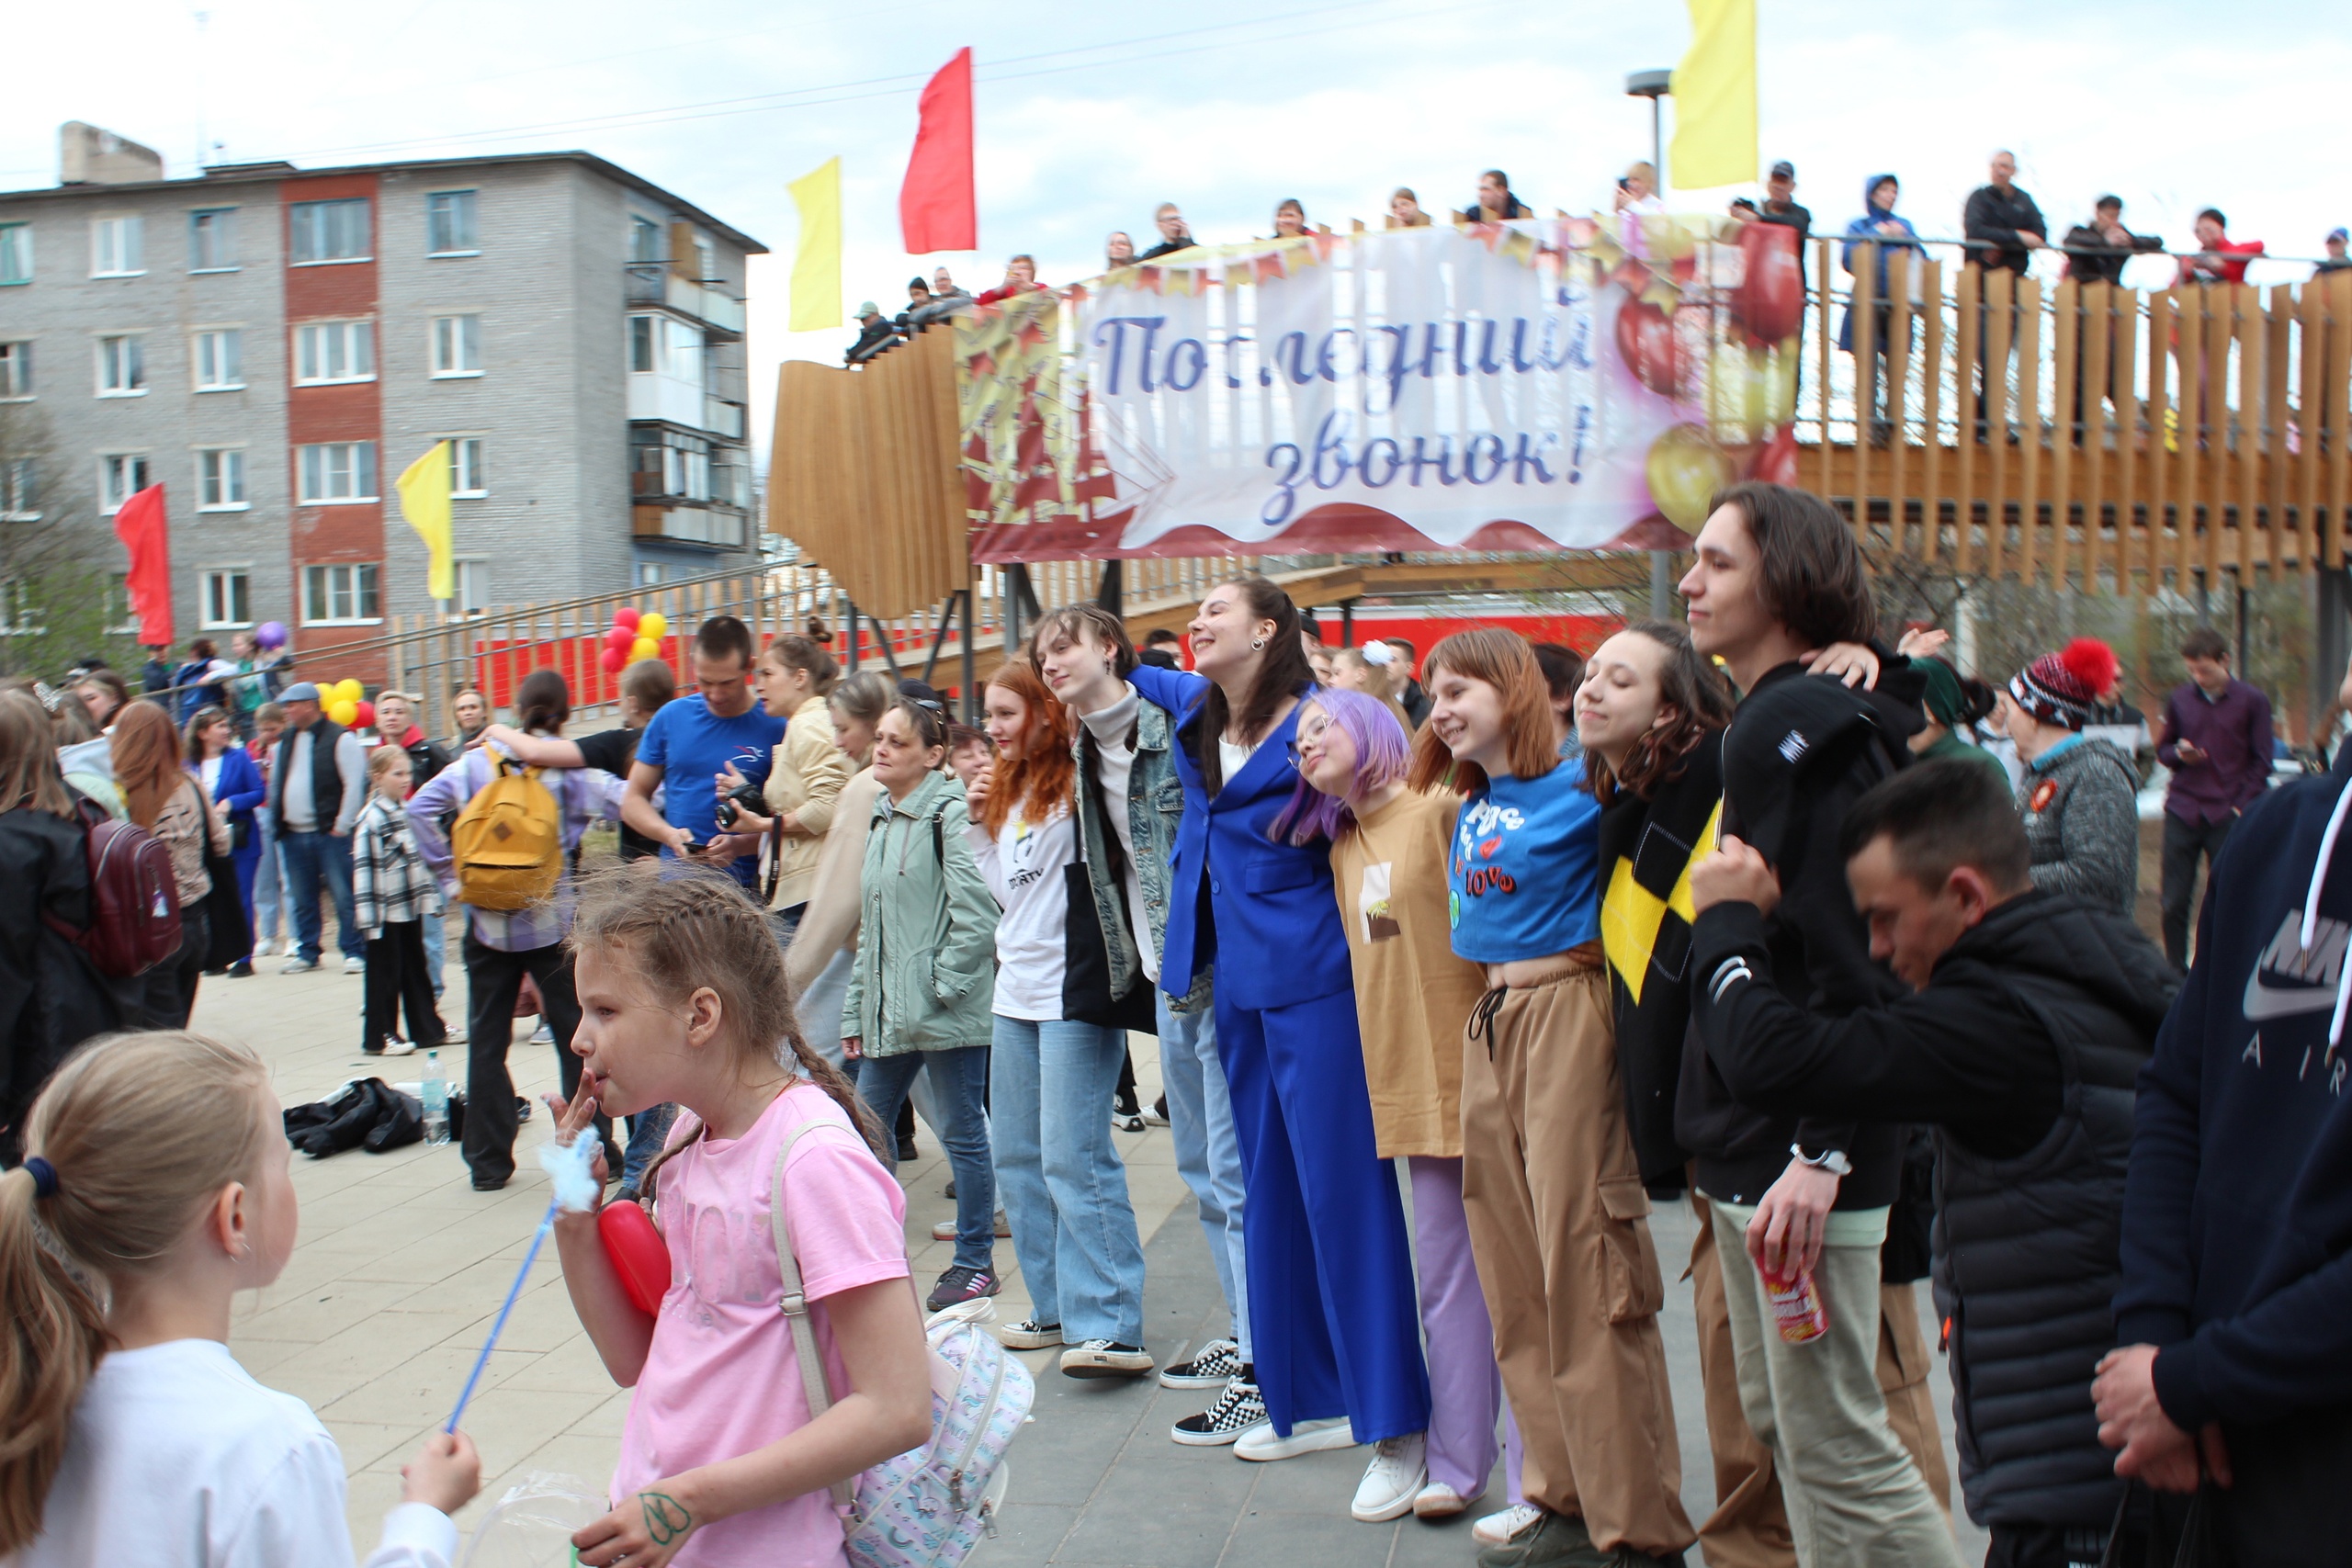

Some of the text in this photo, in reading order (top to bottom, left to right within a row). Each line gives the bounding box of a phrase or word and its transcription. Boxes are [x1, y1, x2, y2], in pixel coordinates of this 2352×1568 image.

[1261, 405, 1590, 526] звонок!
[1466, 866, 1517, 898] love
[2261, 908, 2352, 985] NIK
[2242, 1029, 2347, 1098] AIR
